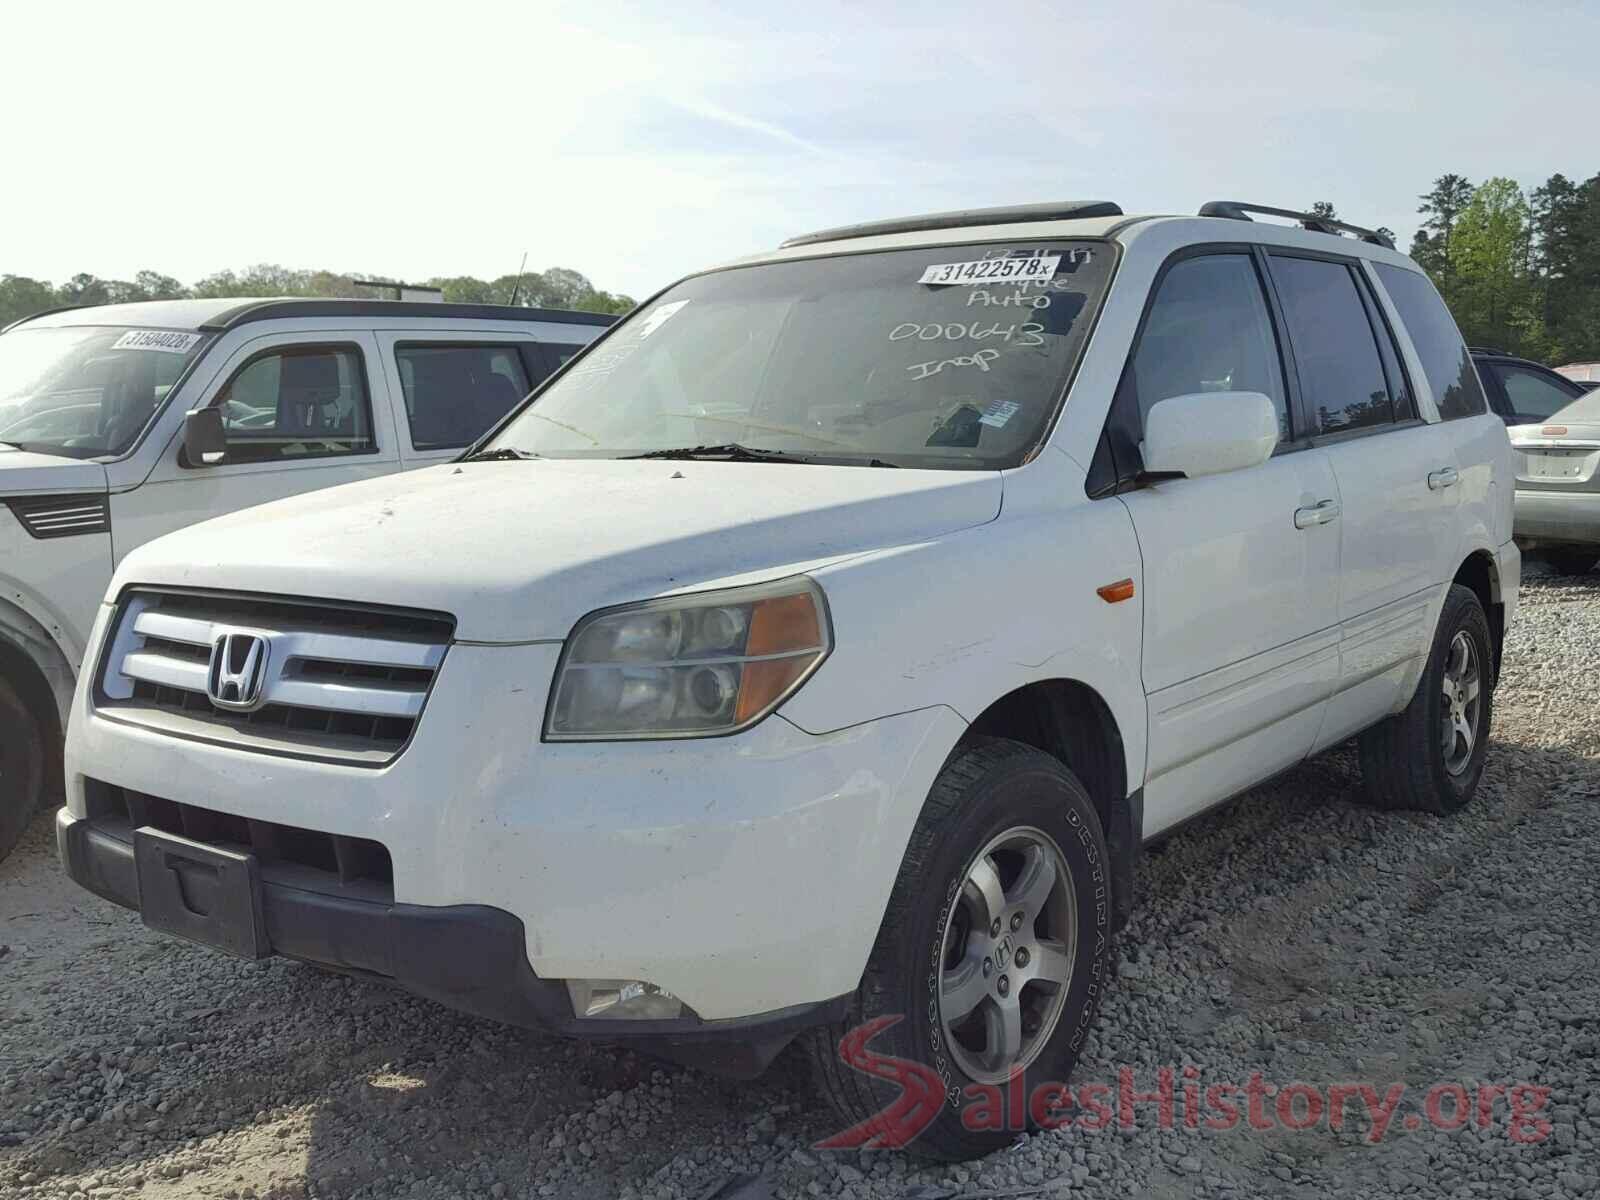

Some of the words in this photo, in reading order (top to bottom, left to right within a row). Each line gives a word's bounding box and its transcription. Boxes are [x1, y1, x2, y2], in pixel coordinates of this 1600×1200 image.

[966, 290, 1050, 309] Auto
[889, 322, 1045, 345] 000643
[1065, 808, 1106, 1050] DESTINATION
